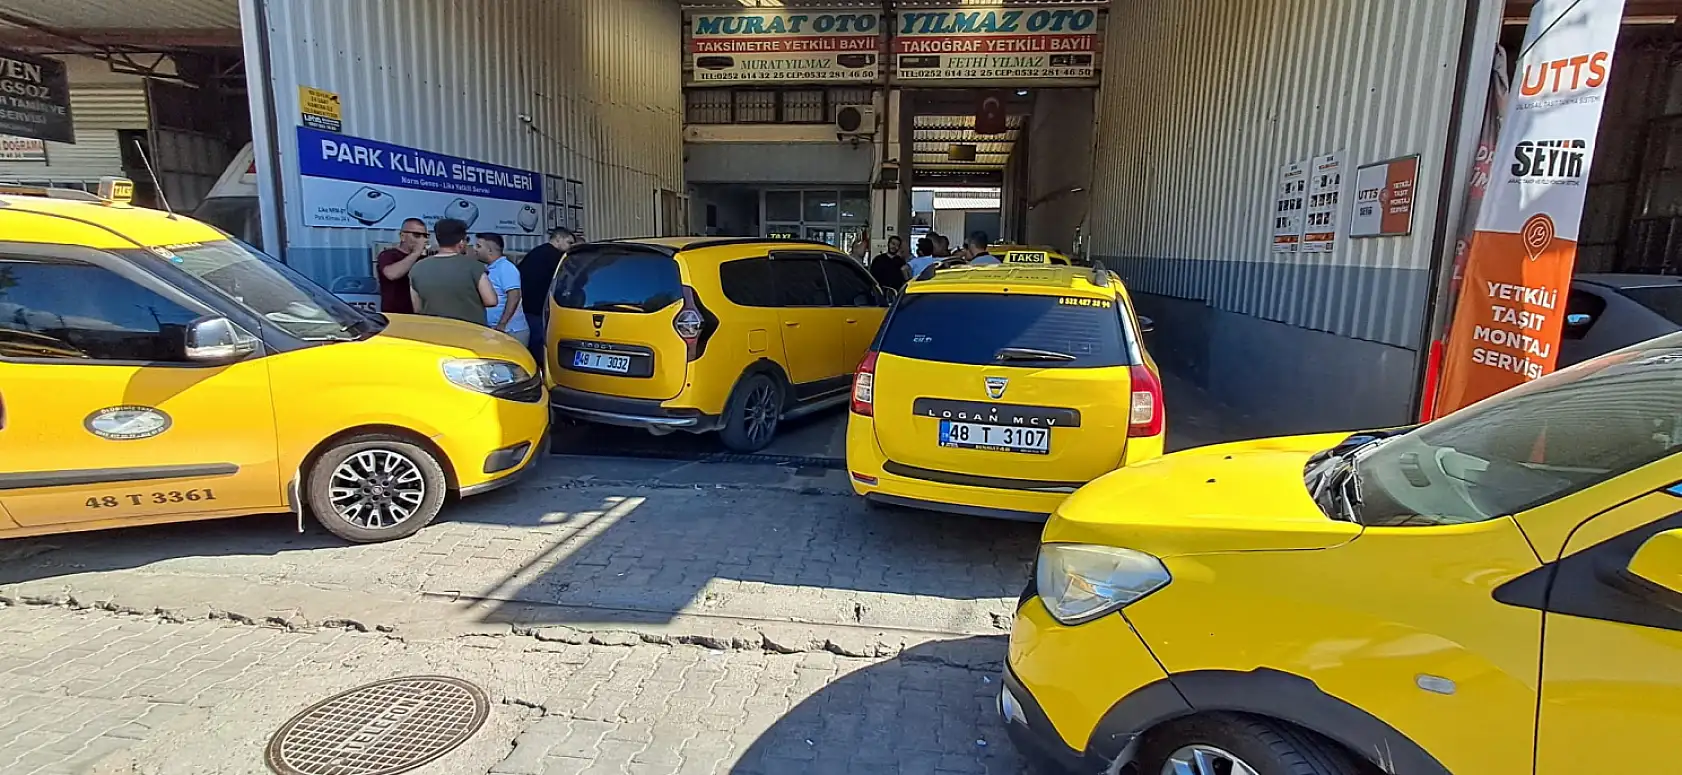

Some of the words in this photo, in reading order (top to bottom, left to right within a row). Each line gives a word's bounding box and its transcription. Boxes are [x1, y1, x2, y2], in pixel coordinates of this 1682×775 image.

[695, 14, 808, 35] MURAT
[812, 14, 876, 33] OTO
[901, 10, 1024, 34] YILMAZ
[1026, 9, 1095, 32] OTO
[697, 39, 780, 52] TAKSİMETRE
[784, 37, 836, 50] YETKİLİ
[839, 36, 875, 50] BAYİİ
[901, 37, 981, 53] TAKOĞRAF
[987, 36, 1046, 52] YETKİLİ
[1051, 35, 1091, 51] BAYİİ
[740, 59, 784, 70] MURAT
[785, 58, 832, 70] YILMAZ
[947, 54, 988, 69] FETHİ
[992, 56, 1044, 68] YILMAZ
[758, 71, 770, 79] 32
[773, 71, 784, 79] 25
[863, 70, 874, 78] 50
[980, 69, 993, 77] 25
[1078, 69, 1091, 77] 50
[1520, 52, 1609, 96] UTTS
[0, 80, 52, 100] GSOZ
[321, 139, 384, 169] PARK
[389, 151, 448, 179] KLİMA
[452, 161, 533, 191] SİSTEMLERİ
[1359, 188, 1379, 201] UTTS
[1487, 281, 1558, 310] YETKİLİ
[1491, 305, 1546, 331] TAŞIT
[1473, 325, 1551, 358] MONTAJ
[595, 355, 601, 367] T
[1472, 348, 1544, 380] SERVİSİ
[928, 409, 998, 423] LOGAN
[1013, 416, 1056, 426] MCV
[950, 424, 969, 441] 48
[982, 426, 991, 444] T
[1003, 428, 1046, 448] 3107
[85, 495, 119, 509] 48
[126, 493, 142, 506] T
[152, 488, 216, 505] 3361
[341, 699, 419, 750] TELEFON
